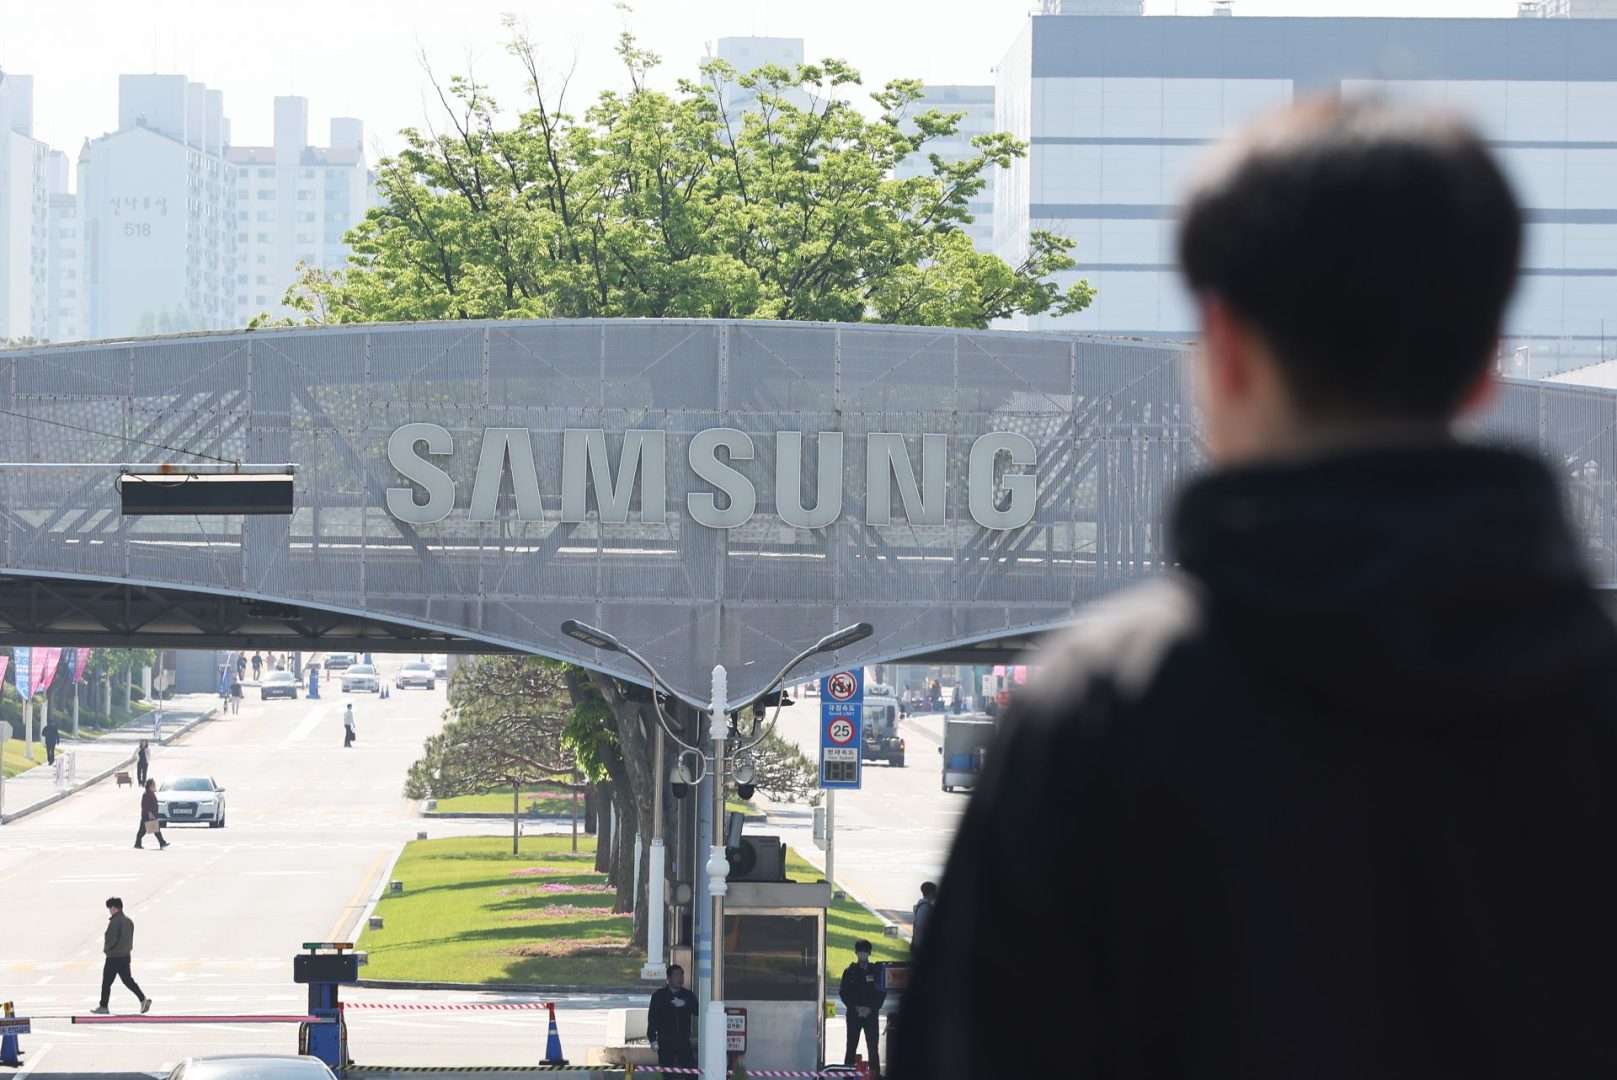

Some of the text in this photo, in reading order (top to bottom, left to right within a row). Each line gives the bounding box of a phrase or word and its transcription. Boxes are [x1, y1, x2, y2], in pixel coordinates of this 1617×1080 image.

[124, 221, 152, 238] 518
[385, 422, 1038, 531] SAMSUNG
[833, 725, 850, 737] 25
